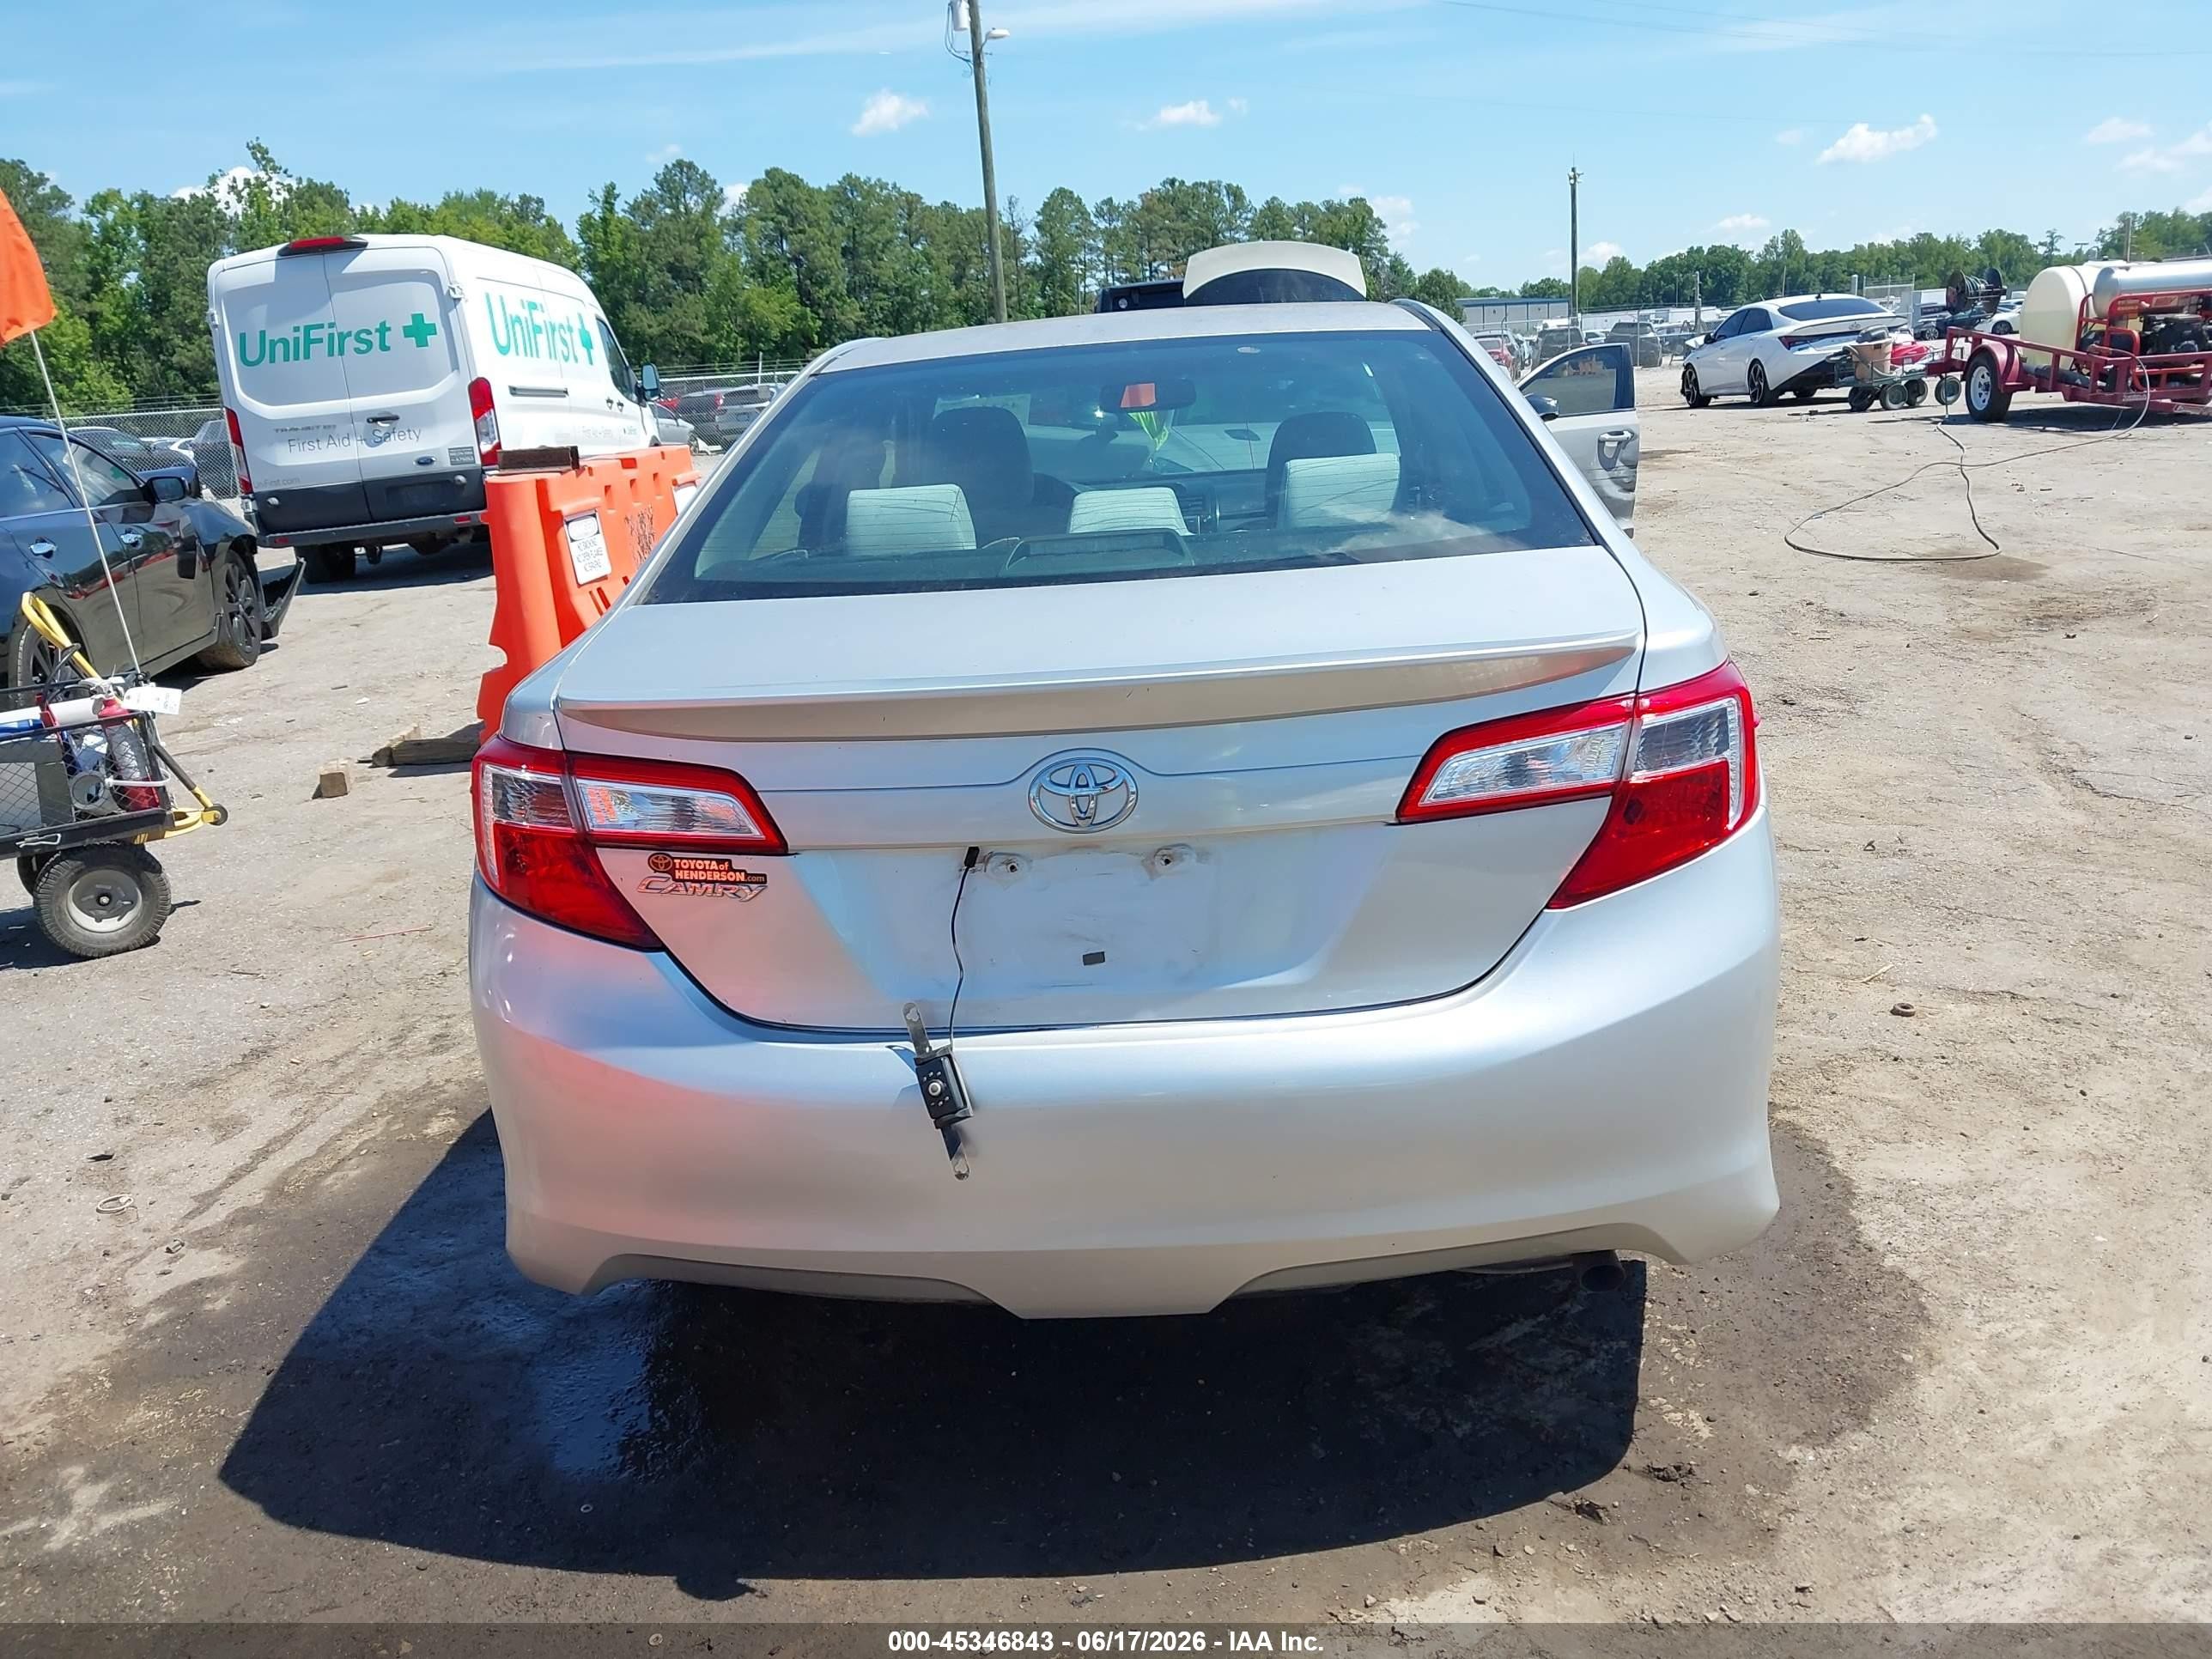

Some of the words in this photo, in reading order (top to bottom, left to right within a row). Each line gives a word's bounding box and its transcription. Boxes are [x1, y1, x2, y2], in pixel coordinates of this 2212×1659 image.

[484, 292, 579, 364] UniFirst
[239, 319, 392, 368] UniFirst
[288, 435, 321, 453] First
[326, 433, 350, 448] Aid
[372, 427, 422, 444] Safety
[674, 860, 717, 870] TOYOTA
[719, 861, 729, 870] of
[675, 870, 765, 882] HENDERSON.com
[636, 876, 768, 902] CAMRY
